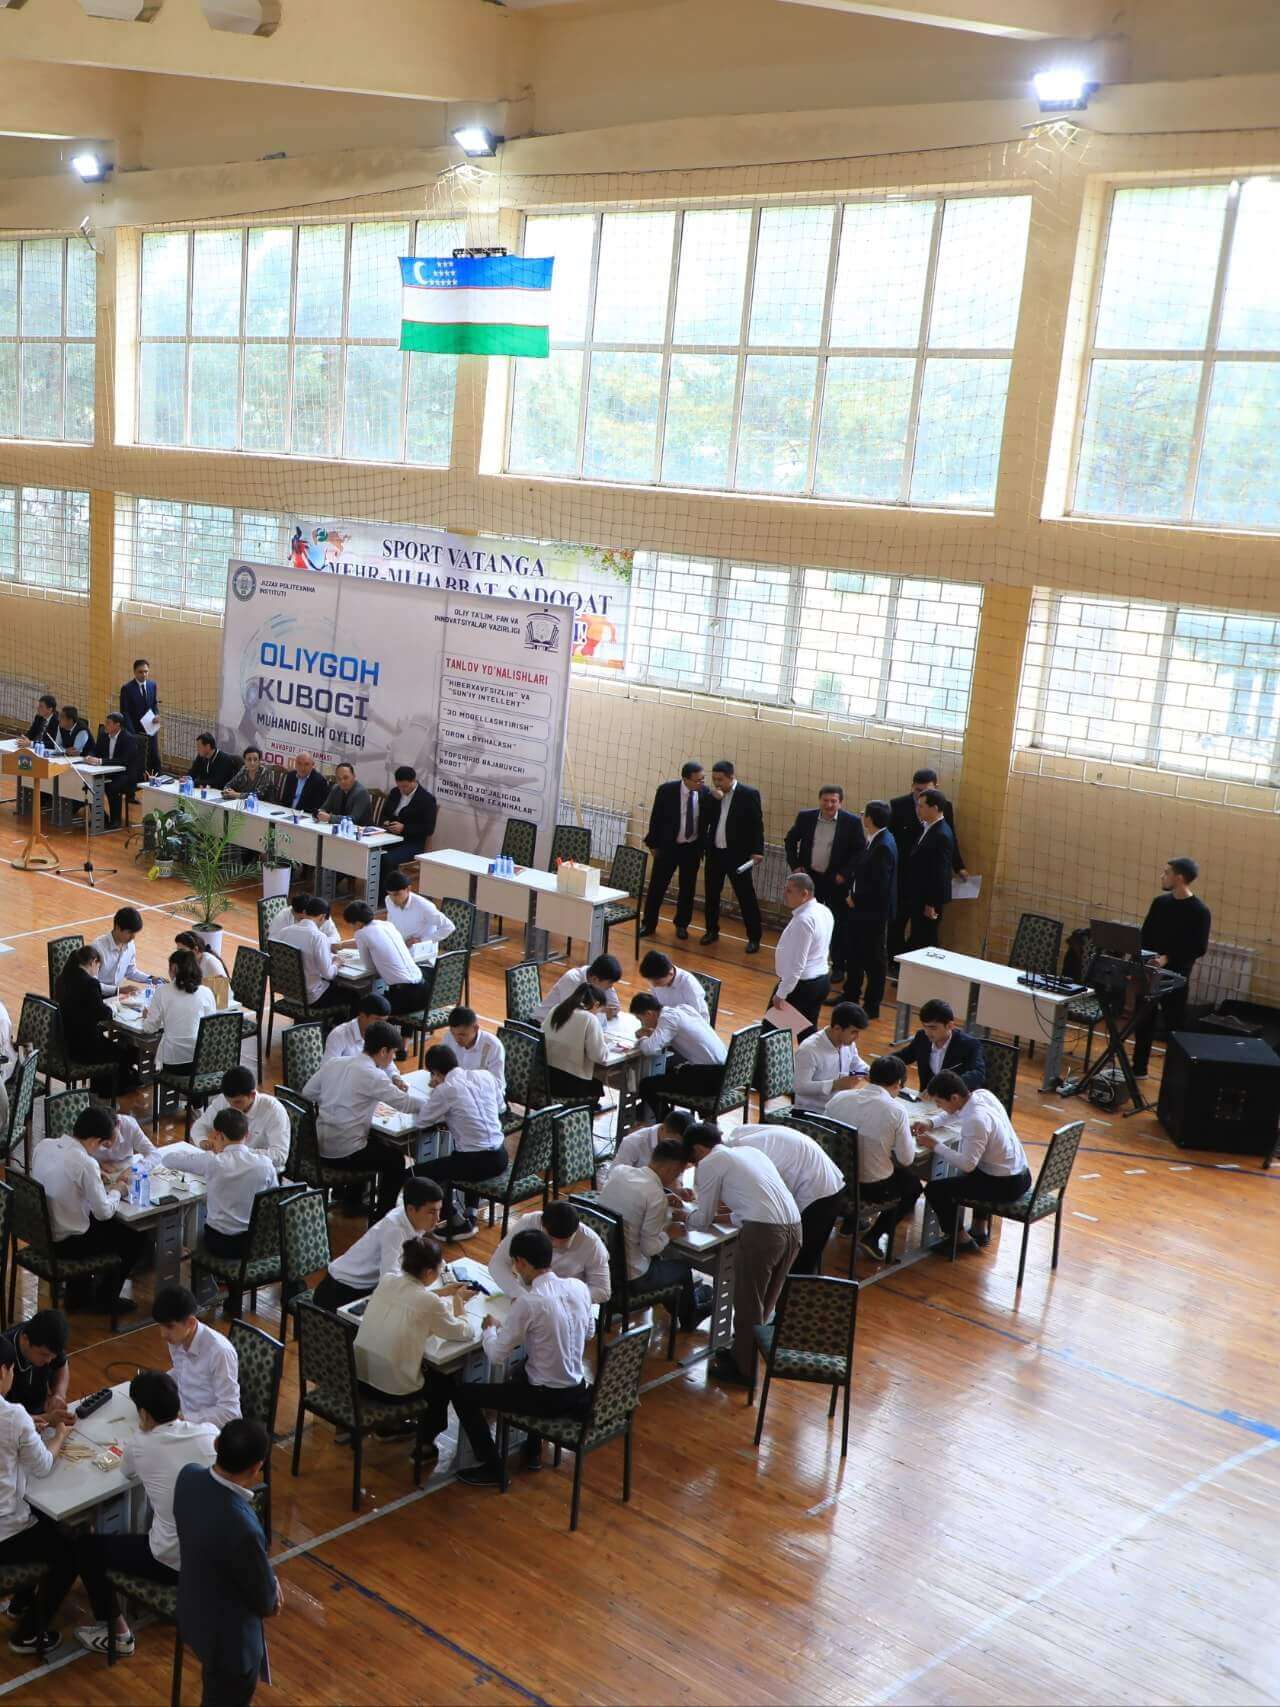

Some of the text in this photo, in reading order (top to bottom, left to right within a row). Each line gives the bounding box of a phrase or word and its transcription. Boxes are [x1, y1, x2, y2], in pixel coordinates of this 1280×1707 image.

[382, 539, 545, 577] SPORT VATANGA
[260, 588, 287, 598] INSTITUTI
[434, 615, 521, 635] INNOVATSIYALAR VAZIRLIGI
[454, 609, 470, 617] OLIY
[496, 615, 510, 624] FAN
[510, 617, 520, 625] VA
[260, 642, 380, 687] OLIYGOH
[446, 658, 480, 672] TANLOV
[258, 677, 370, 721] KUBOGI
[520, 693, 530, 701] VA
[257, 713, 366, 748] MUHANDISLIK OYLIGI
